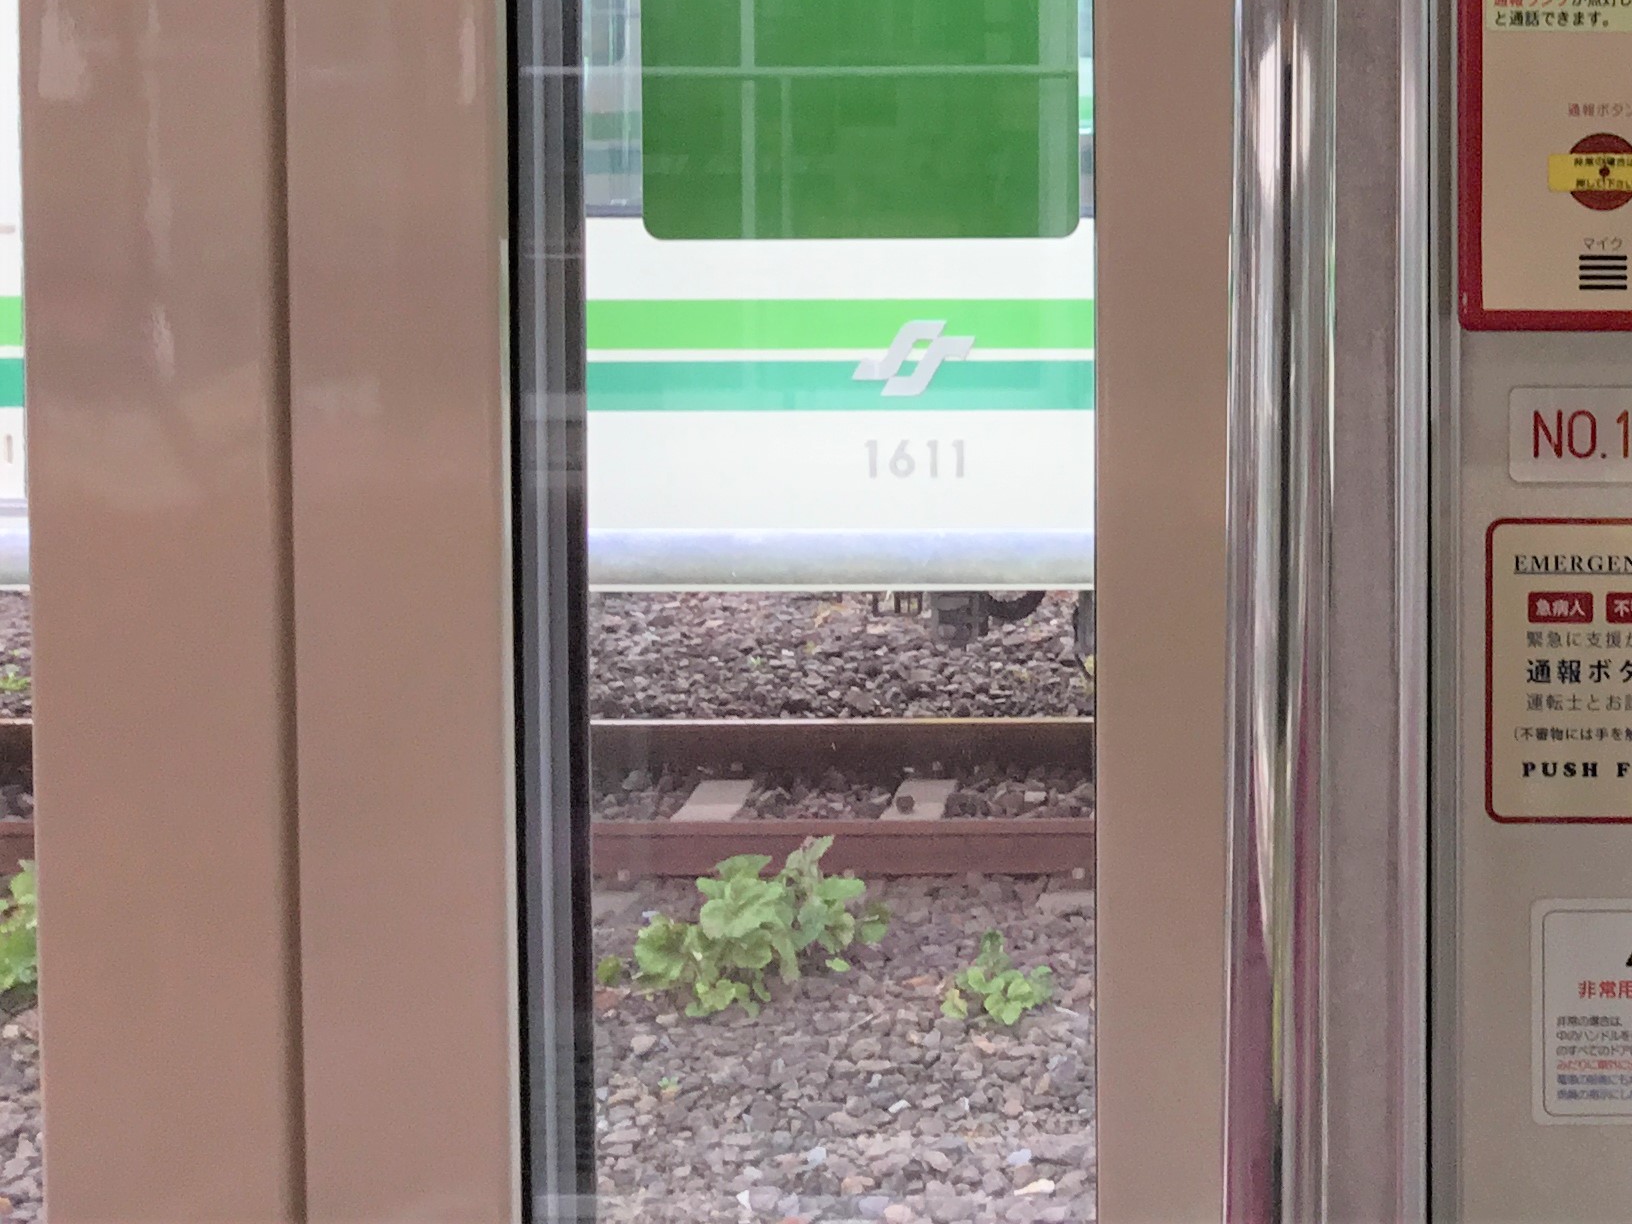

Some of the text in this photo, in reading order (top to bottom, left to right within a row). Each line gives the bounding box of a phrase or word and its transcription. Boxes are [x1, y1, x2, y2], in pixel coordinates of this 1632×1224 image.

[1494, 10, 1610, 27] と通話できます。
[1583, 237, 1623, 250] マイク
[864, 439, 966, 478] 1611
[1535, 599, 1586, 617] 急病人
[1522, 762, 1598, 777] PUSH
